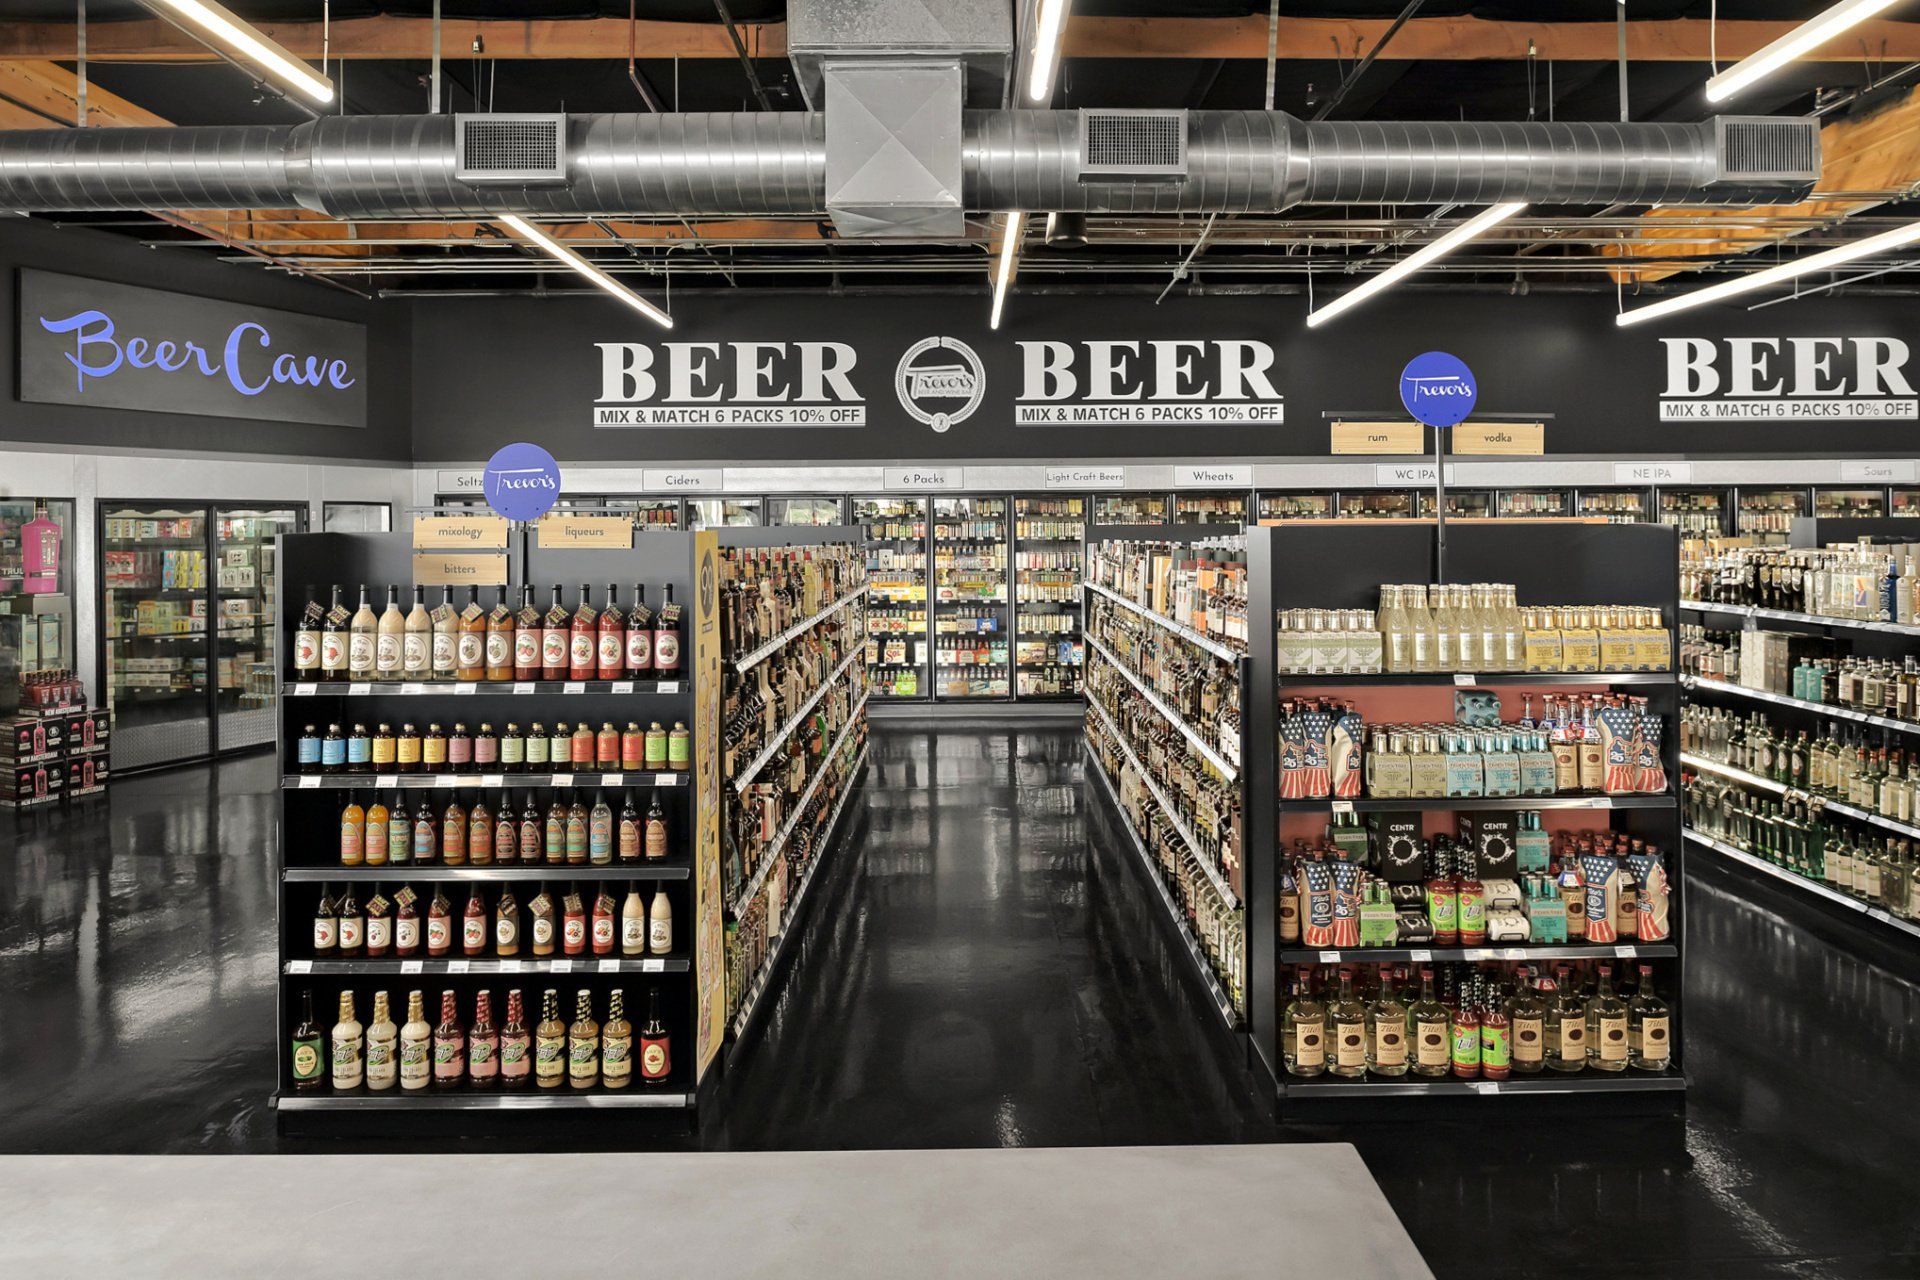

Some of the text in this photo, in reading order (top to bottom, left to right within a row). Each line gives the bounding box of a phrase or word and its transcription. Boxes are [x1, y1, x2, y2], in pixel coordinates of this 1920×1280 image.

[40, 310, 355, 395] Beer Cave
[594, 342, 865, 402] BEER
[1015, 340, 1284, 400] BEER
[1659, 338, 1918, 396] BEER
[1405, 376, 1473, 402] Trevor's
[600, 409, 861, 423] MIX & MATCH 6 PACKS 10% OFF
[1021, 407, 1278, 421] MIX & MATCH 6 PACKS 10% OFF
[1666, 403, 1913, 417] MIX & MATCH 6 PACKS 10% OFF
[1484, 433, 1512, 443] vodka
[1046, 472, 1124, 482] Light Craft Beers
[1192, 471, 1234, 481] Wheats
[1396, 470, 1436, 480] WC IPA
[1633, 468, 1672, 479] NE IPA
[1864, 466, 1893, 476] Sours
[488, 468, 556, 496] Trevor's
[665, 475, 700, 486] Ciders
[903, 473, 945, 484] 6 Packs
[438, 526, 483, 540] mixology
[565, 526, 604, 540] liqueurs
[444, 564, 476, 574] bitters
